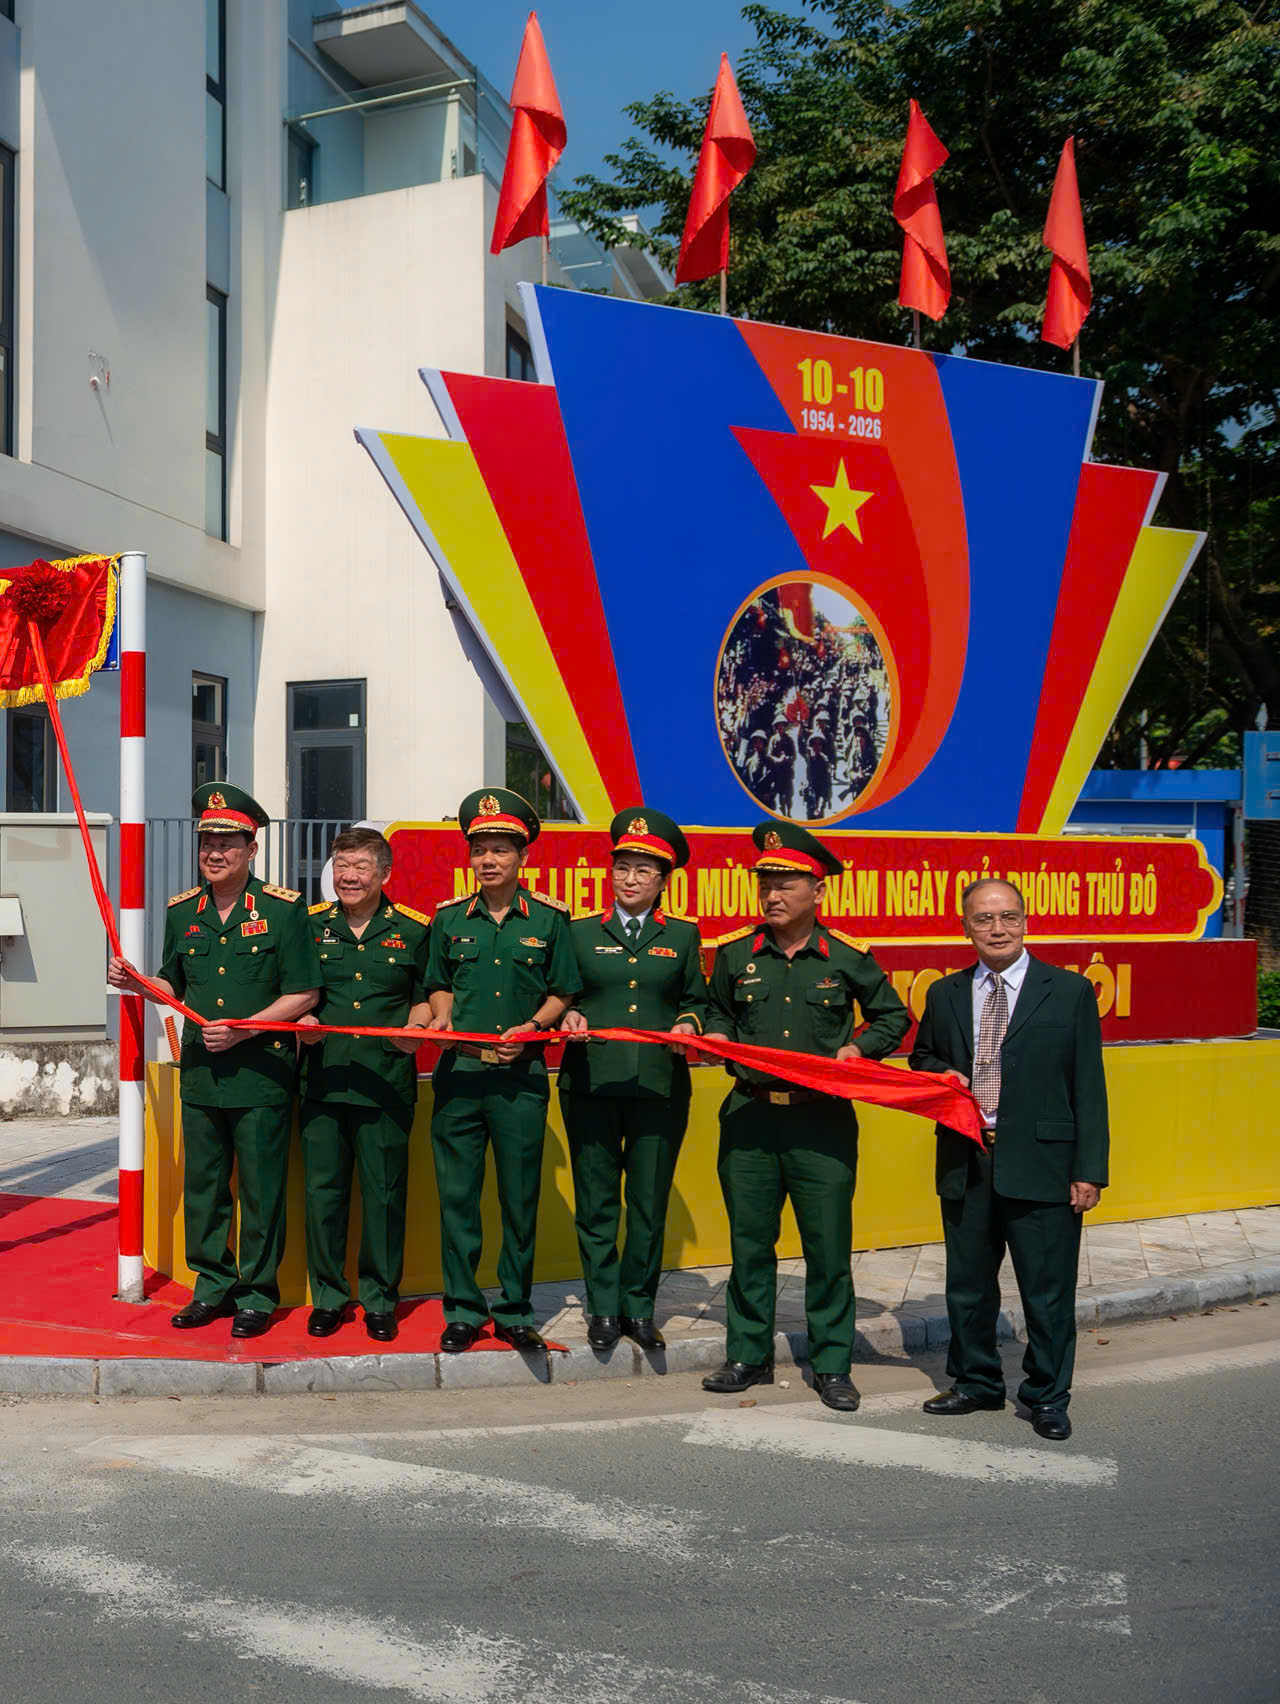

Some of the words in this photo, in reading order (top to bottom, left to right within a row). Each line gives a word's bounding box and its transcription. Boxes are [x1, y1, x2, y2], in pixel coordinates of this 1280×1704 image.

[801, 408, 834, 432] 1954
[848, 415, 881, 439] 2026
[697, 858, 765, 917] MỪN
[821, 859, 878, 917] NĂM
[885, 860, 949, 917] NGÀY
[1085, 857, 1125, 916] THỦ
[1129, 863, 1158, 916] ĐÔ
